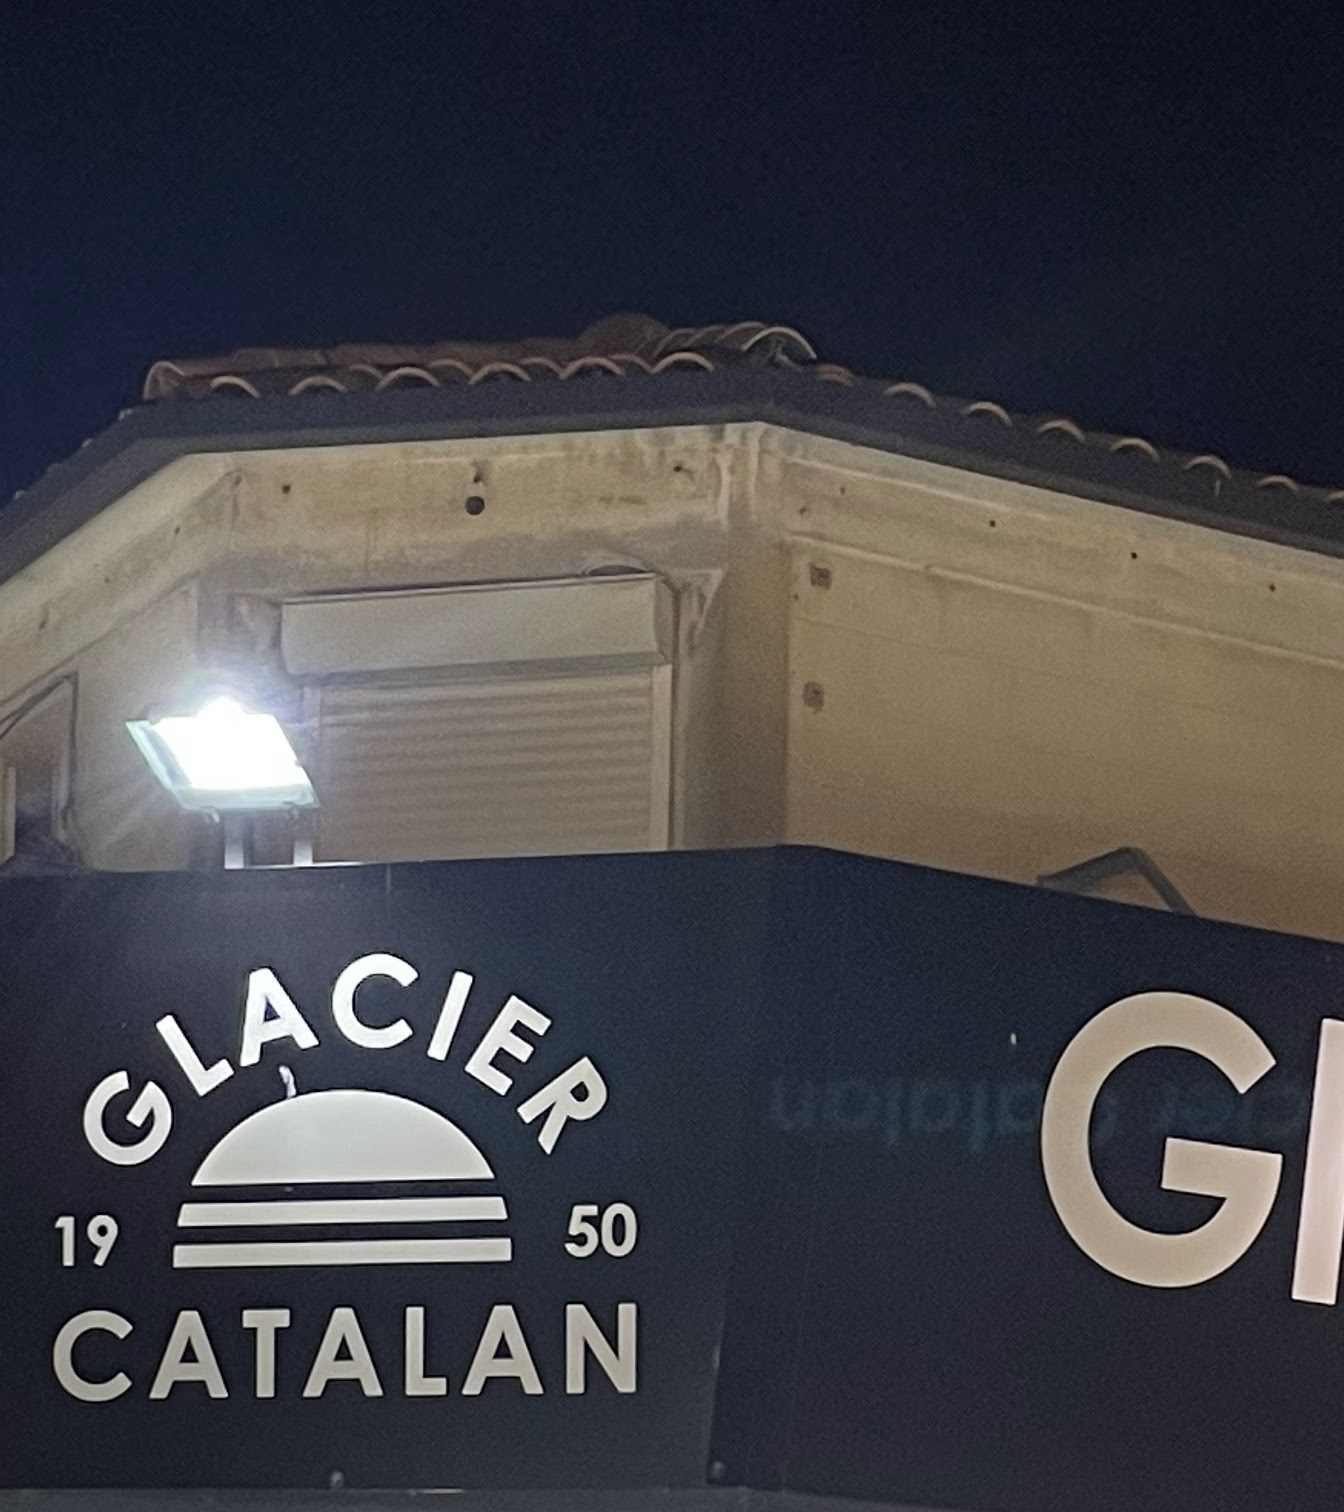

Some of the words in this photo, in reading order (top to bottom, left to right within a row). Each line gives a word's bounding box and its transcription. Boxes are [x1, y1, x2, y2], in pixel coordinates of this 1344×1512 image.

[83, 953, 608, 1165] GLACIER
[55, 1214, 119, 1267] 19
[565, 1202, 638, 1258] 50
[54, 1303, 637, 1402] CATALAN
